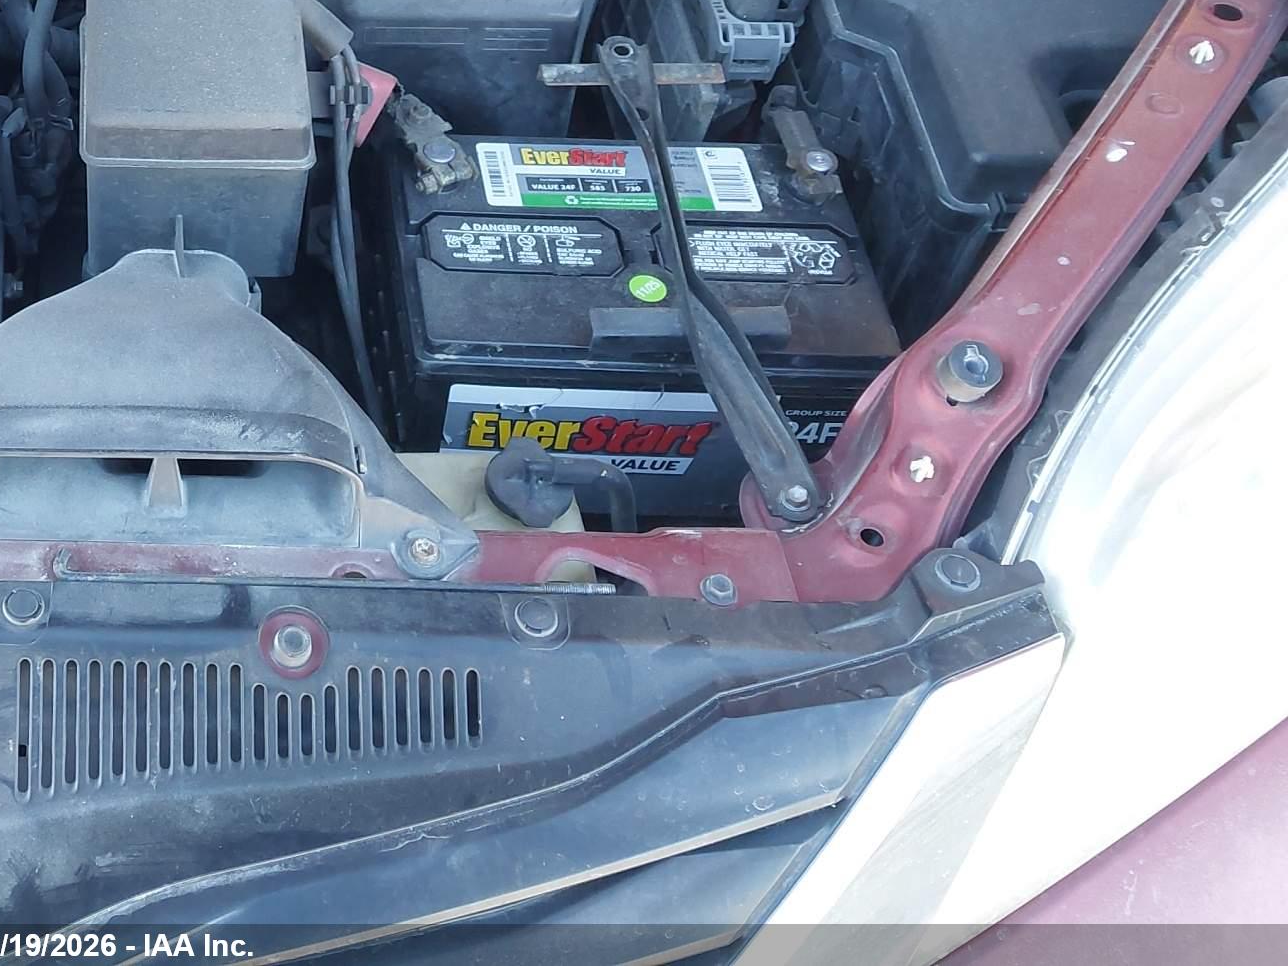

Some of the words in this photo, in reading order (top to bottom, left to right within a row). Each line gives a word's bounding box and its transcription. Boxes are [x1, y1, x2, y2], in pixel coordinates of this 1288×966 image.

[520, 148, 626, 166] EverStart
[531, 183, 560, 191] VALUE
[472, 223, 522, 232] DANGER
[533, 225, 578, 233] POISON
[467, 411, 712, 455] EverStart
[611, 458, 681, 471] VALUE
